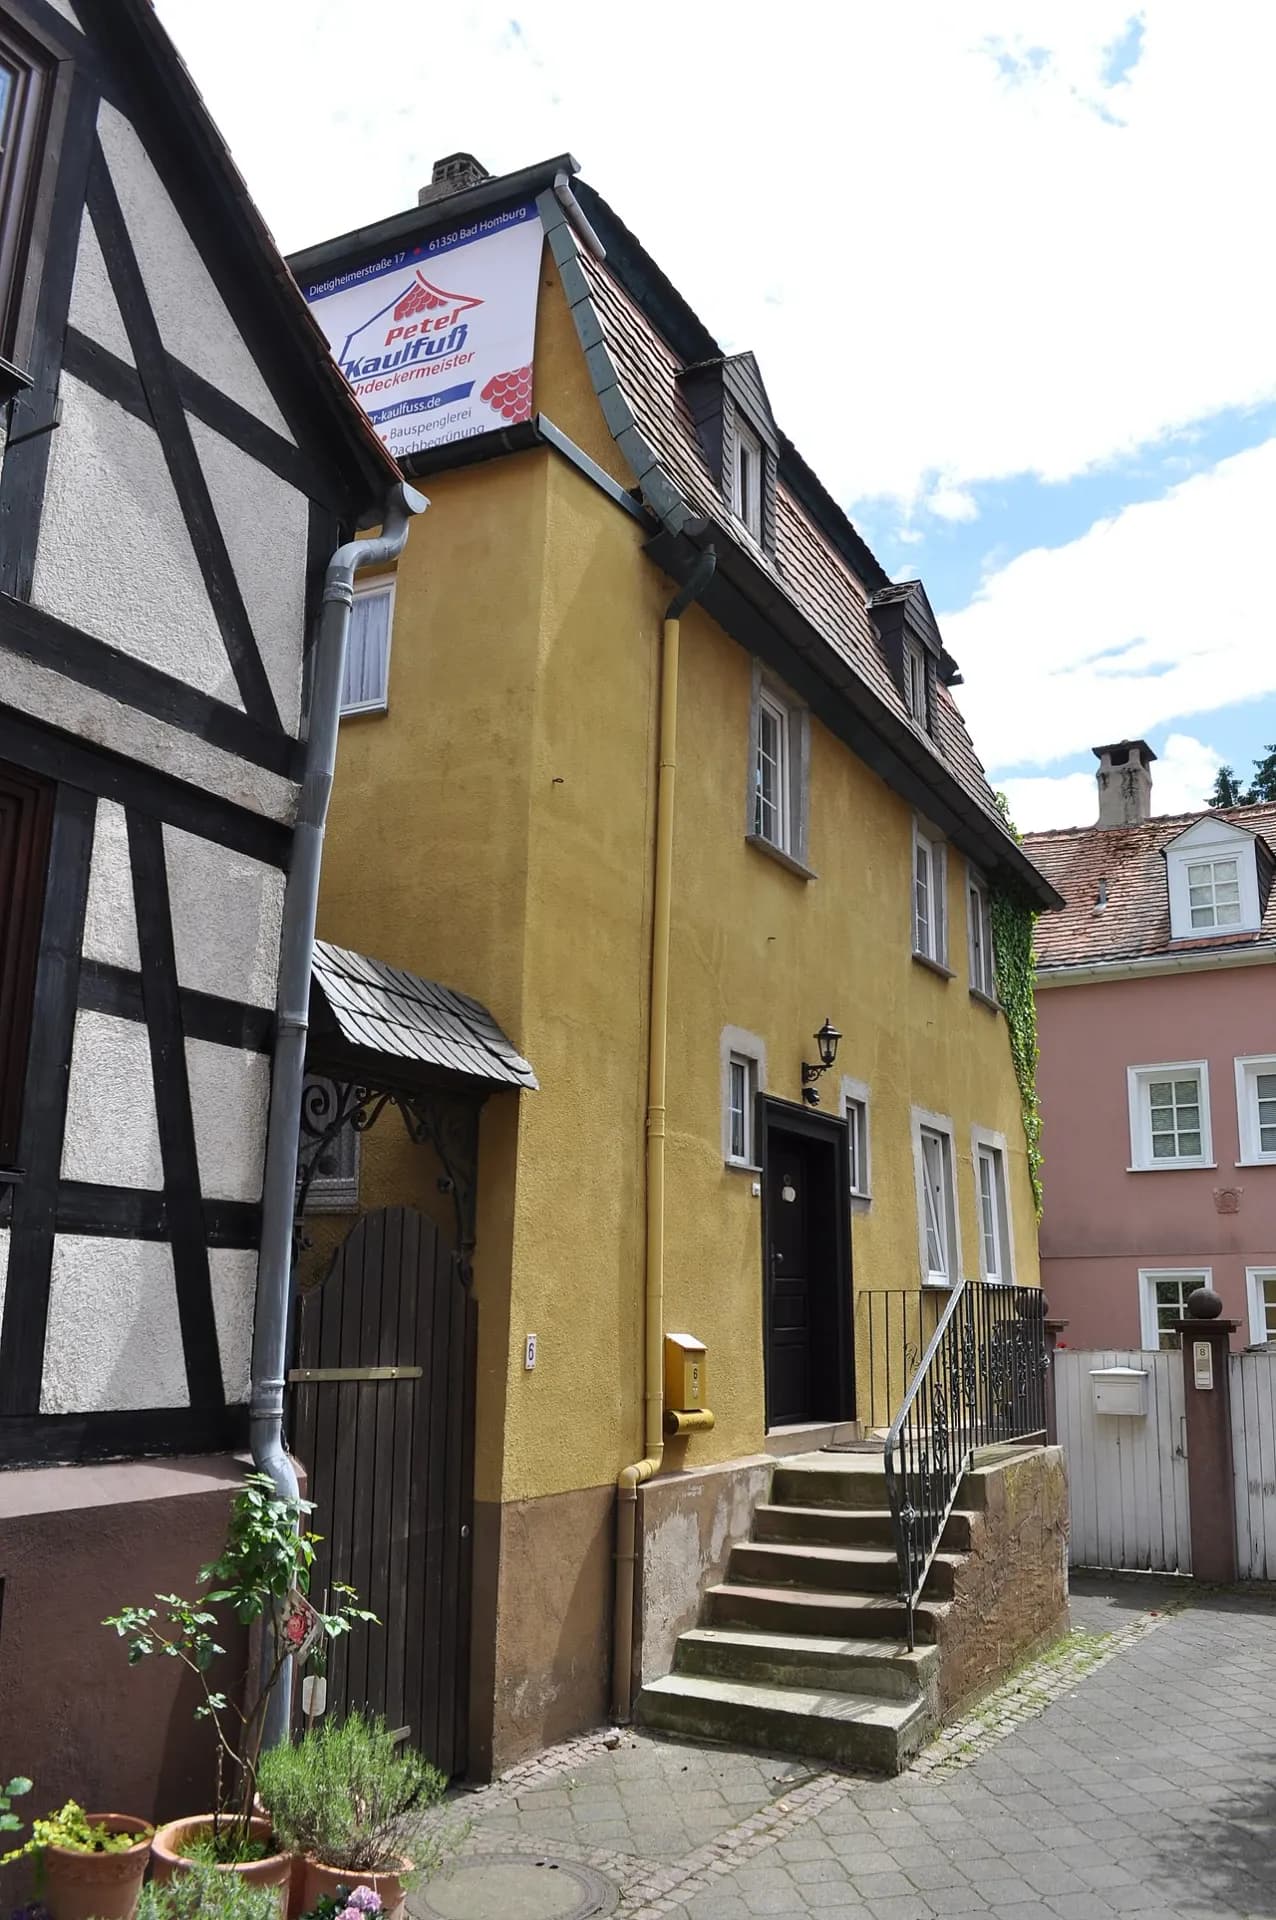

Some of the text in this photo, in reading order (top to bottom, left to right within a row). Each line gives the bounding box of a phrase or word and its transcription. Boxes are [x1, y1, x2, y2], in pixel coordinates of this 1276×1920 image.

[309, 207, 527, 297] Dietigheimerstraße 17 61350 Bad Homburg
[384, 308, 461, 347] Peter
[344, 323, 468, 380] Kaulfuß
[354, 351, 476, 397] hdeckermeister
[389, 407, 472, 440] Bauspenglerei
[528, 1342, 535, 1361] 6
[693, 1367, 698, 1380] 6
